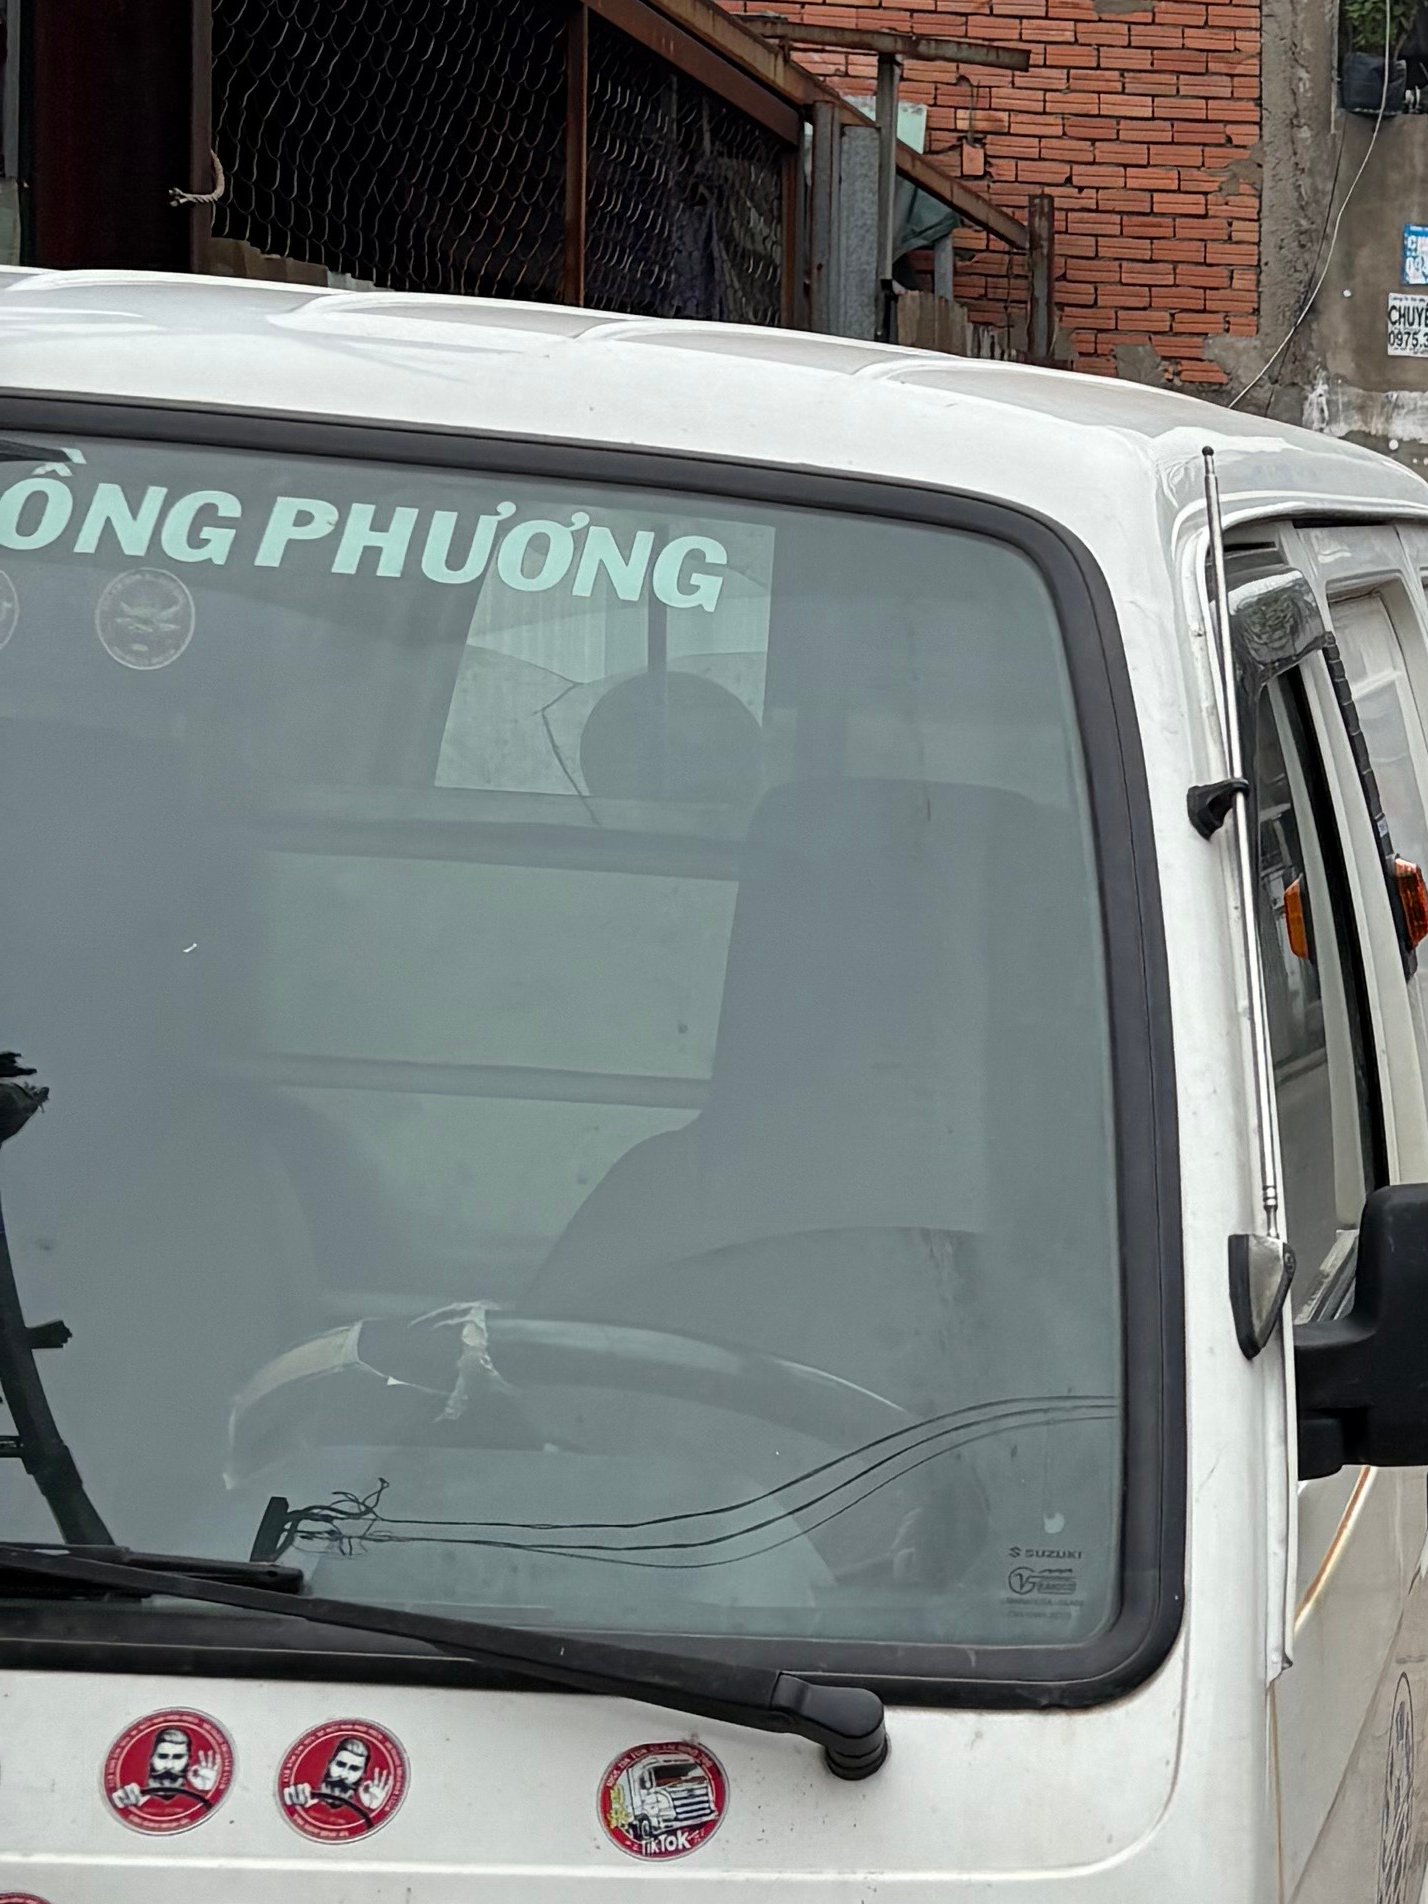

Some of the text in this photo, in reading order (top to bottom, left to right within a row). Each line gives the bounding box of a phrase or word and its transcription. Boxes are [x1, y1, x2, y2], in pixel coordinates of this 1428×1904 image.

[254, 496, 729, 613] PHƯƠNG
[1024, 1549, 1083, 1559] SUZUKI
[641, 1830, 692, 1856] TikTok
